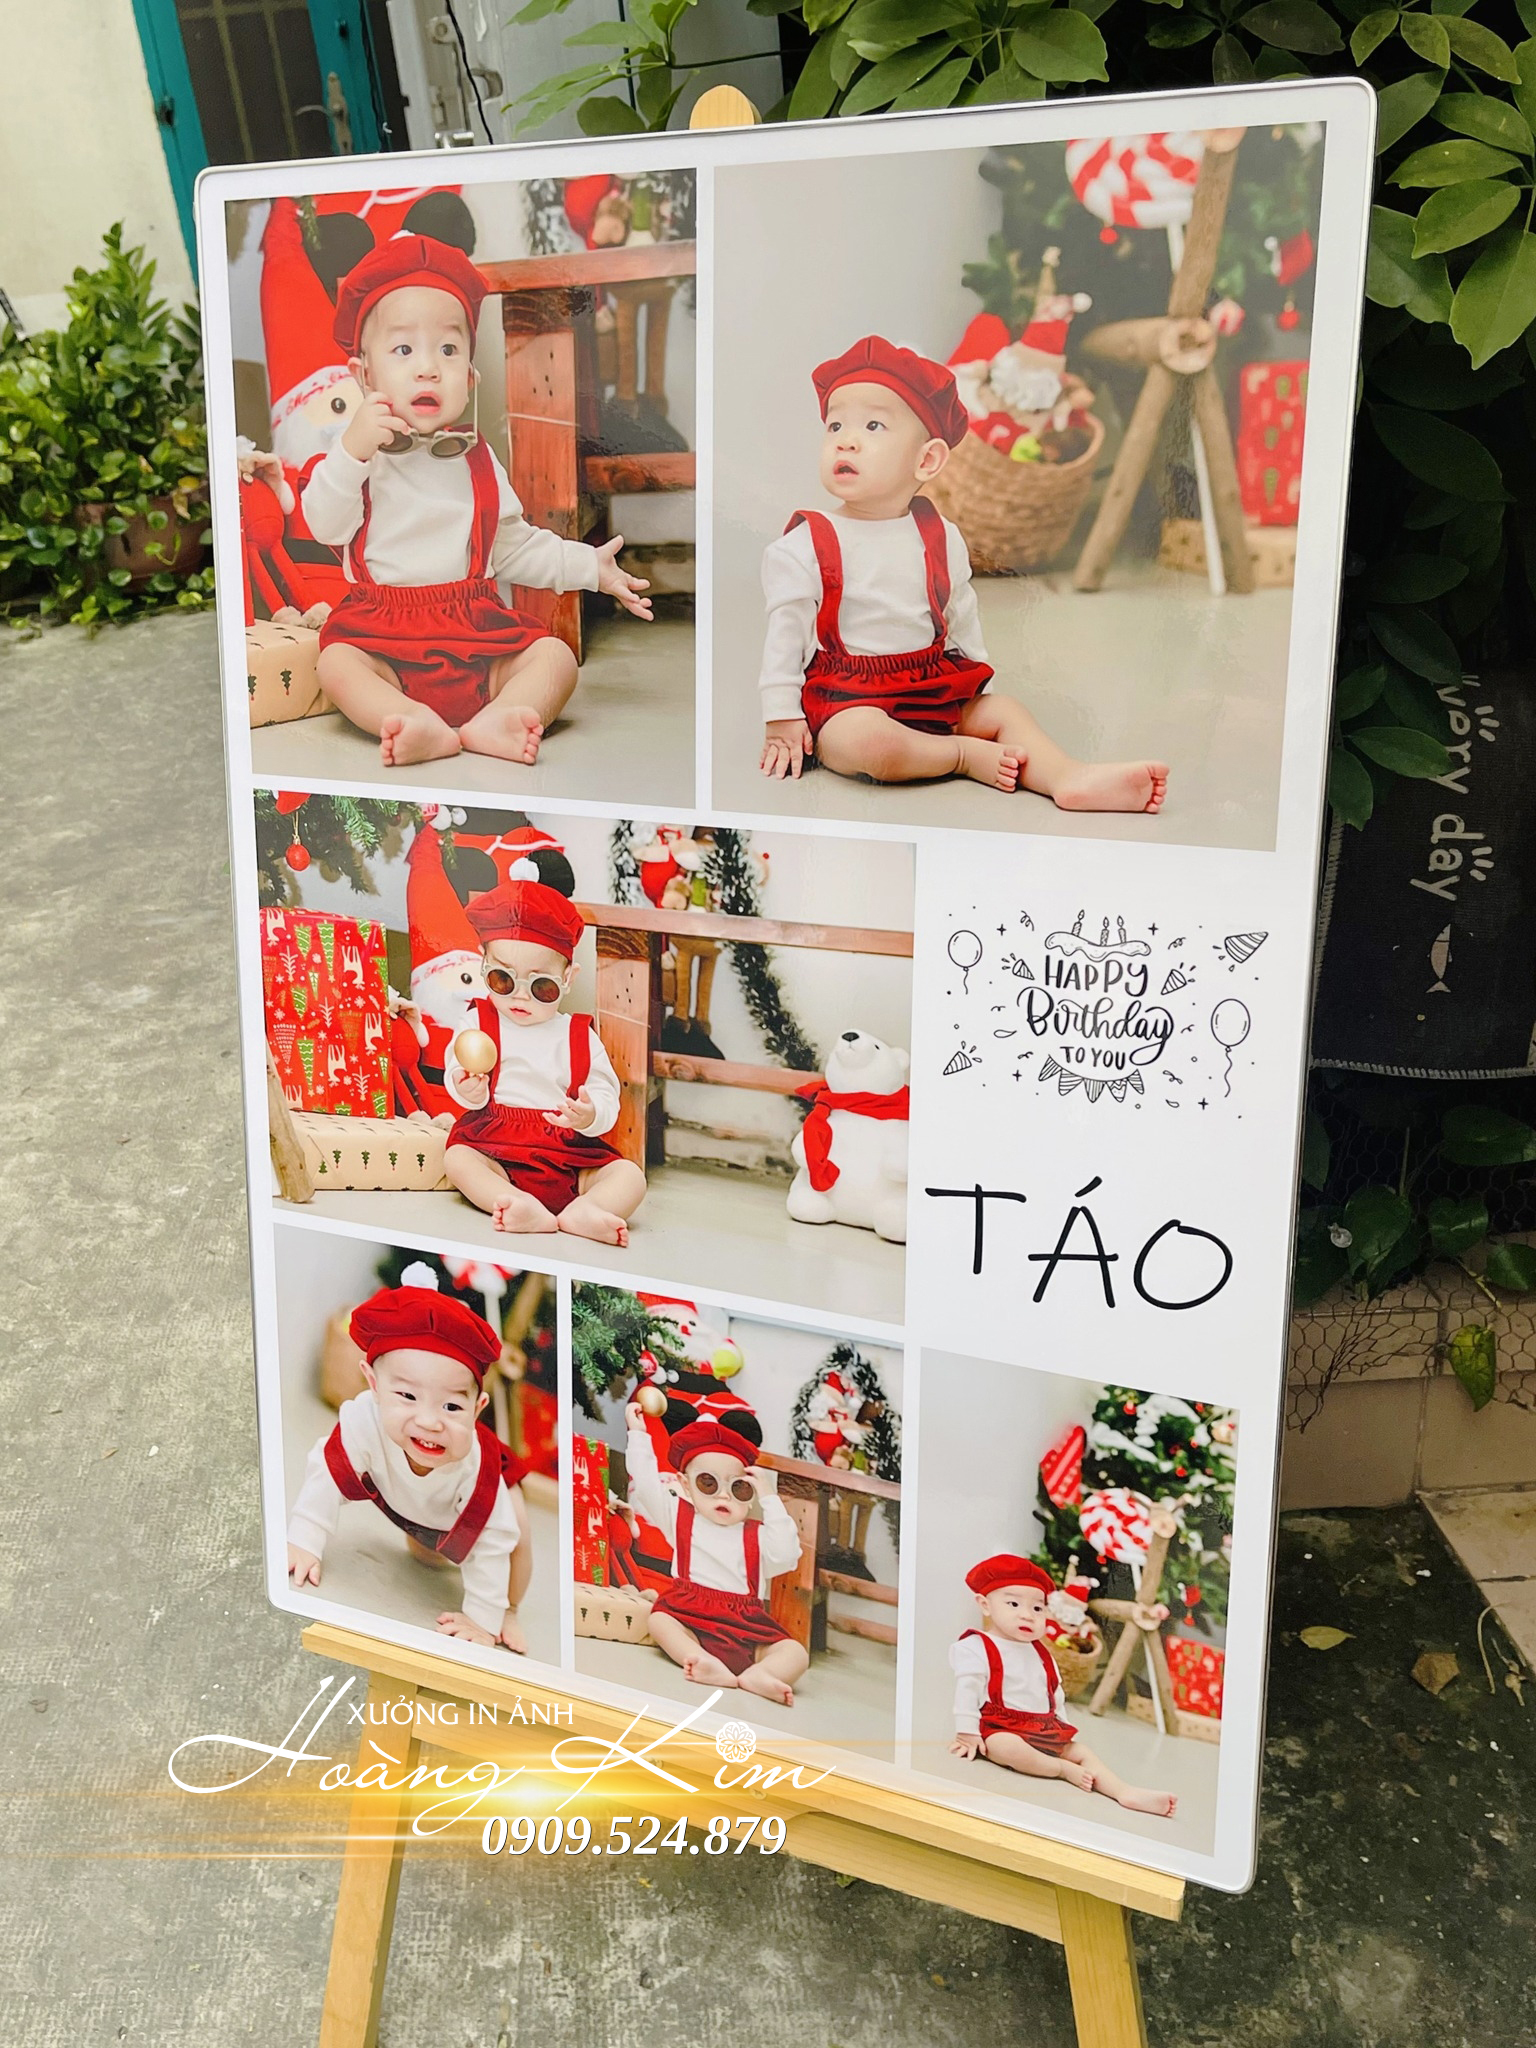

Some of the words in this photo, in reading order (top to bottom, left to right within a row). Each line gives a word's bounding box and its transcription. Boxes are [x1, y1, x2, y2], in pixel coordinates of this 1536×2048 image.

[1410, 813, 1486, 901] day
[1044, 954, 1148, 997] HAPPY
[1016, 986, 1174, 1066] Birthday
[1060, 1046, 1085, 1064] TO
[1091, 1047, 1126, 1071] YOU
[925, 1176, 1233, 1310] TÁO
